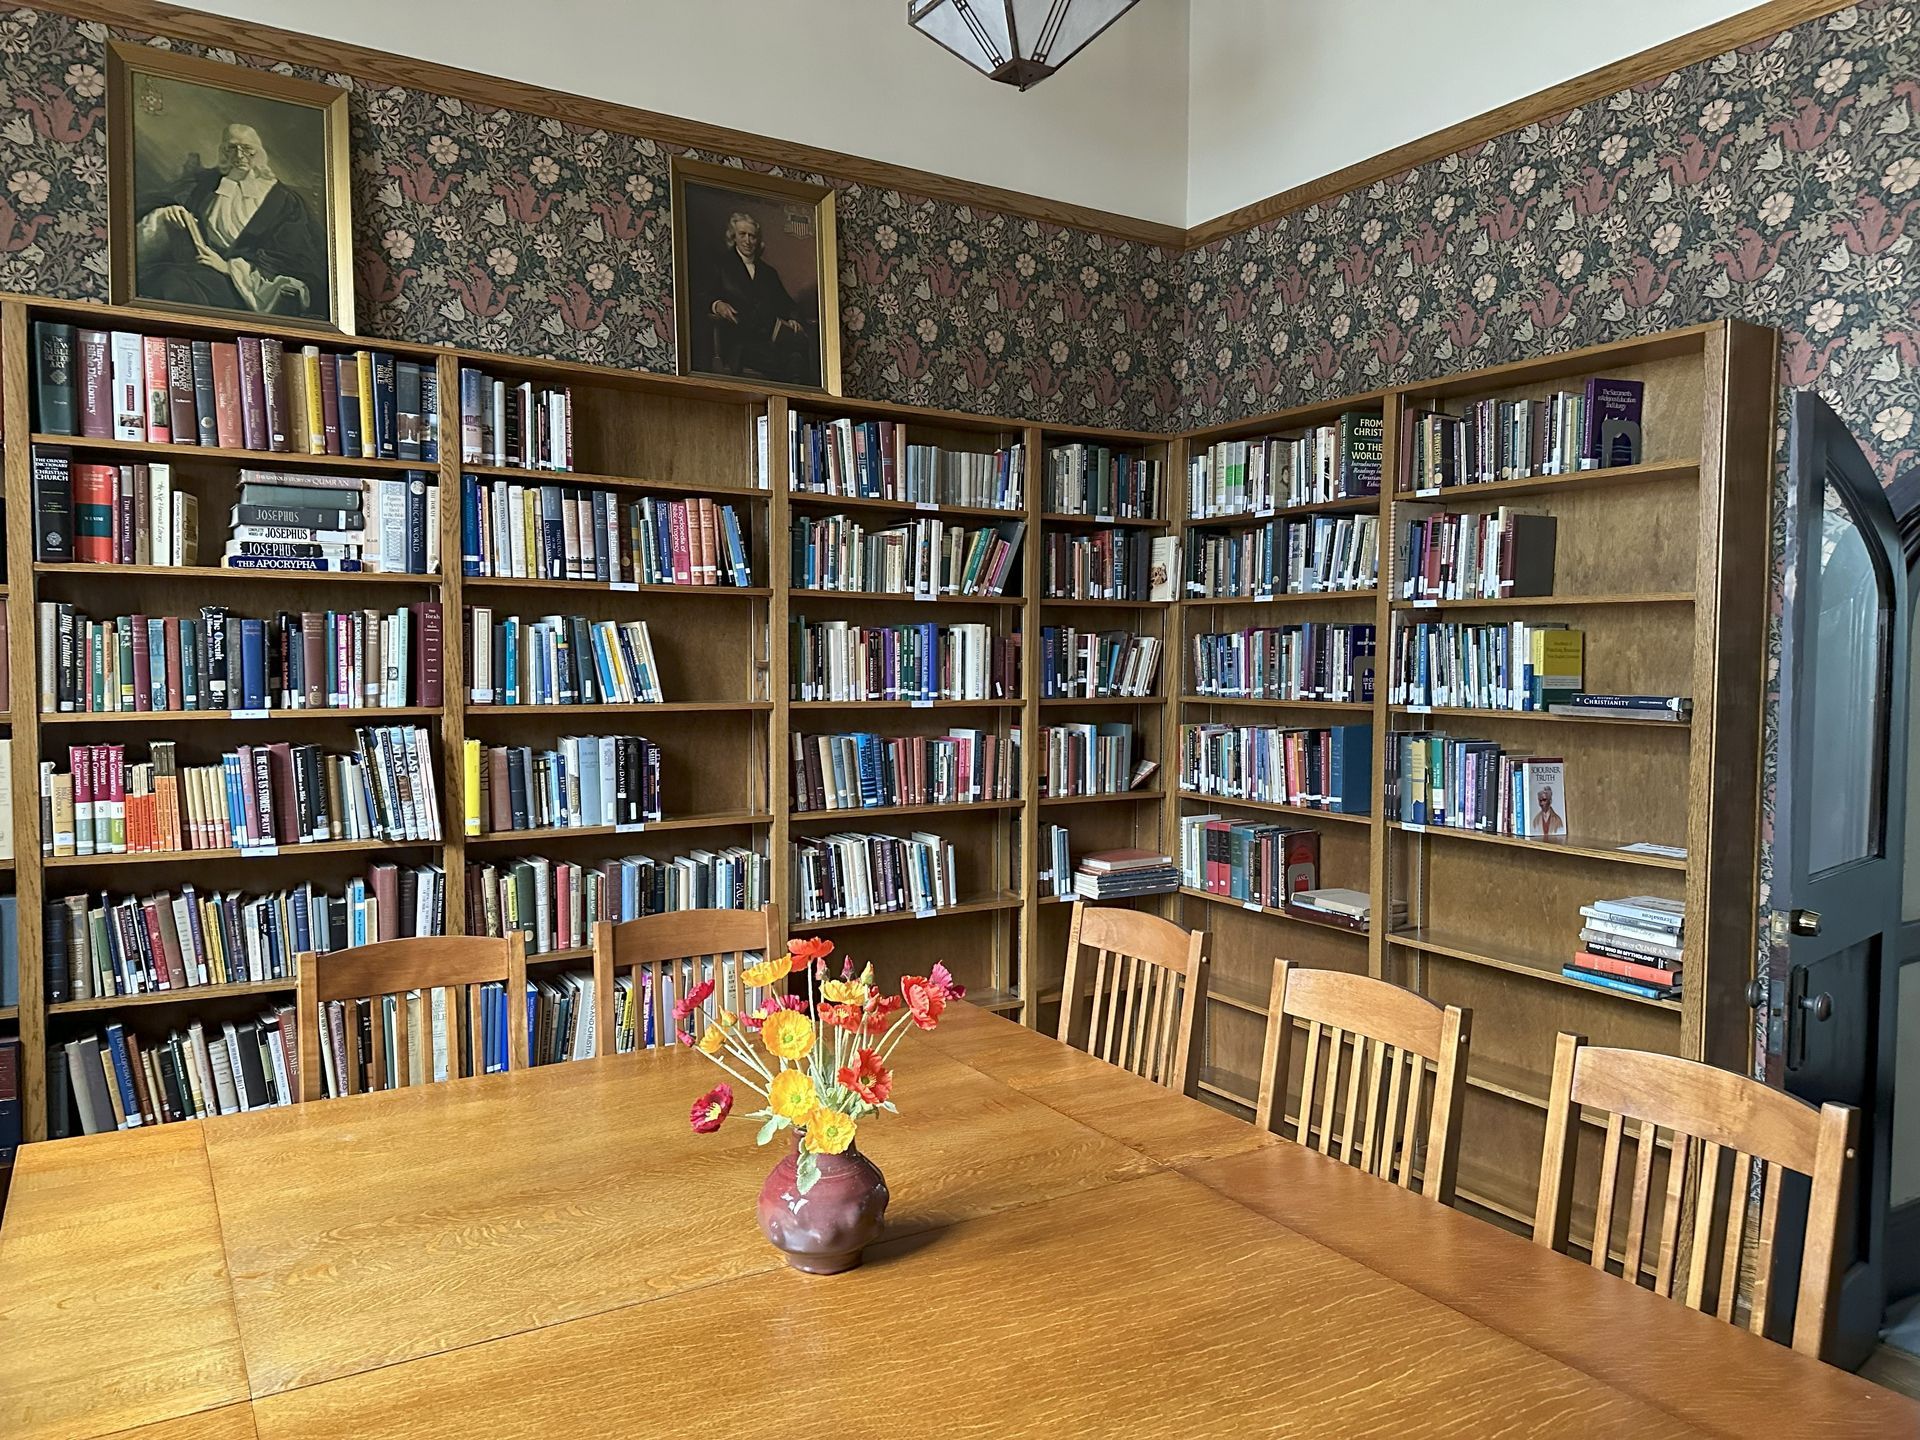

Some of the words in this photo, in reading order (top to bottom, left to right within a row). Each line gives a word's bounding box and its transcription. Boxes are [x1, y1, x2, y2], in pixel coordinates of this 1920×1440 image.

[1614, 403, 1626, 411] Liturgy
[1360, 419, 1383, 427] FROM
[1354, 428, 1383, 436] CHRIST
[1354, 442, 1366, 450] TO
[1368, 443, 1383, 451] THE
[1352, 452, 1382, 460] WORLD
[313, 477, 349, 486] QUMRAN
[256, 510, 300, 522] JOSEPHUS
[609, 510, 617, 522] Old
[265, 528, 308, 539] JOSEPHUS
[677, 506, 685, 545] Encyclopedia
[673, 525, 681, 552] Prophecy
[248, 543, 297, 556] JOSEPHUS
[610, 531, 618, 564] Testament
[237, 560, 255, 568] THE
[256, 559, 317, 569] APOCRYPHA
[60, 614, 72, 635] Billy
[213, 613, 223, 630] The
[61, 635, 73, 667] Graham
[214, 632, 224, 660] Occult
[1584, 698, 1629, 706] CHRISTIANITY
[256, 756, 267, 764] HE
[392, 744, 403, 774] ATLAS
[398, 776, 408, 786] OF
[406, 743, 417, 771] ATLAS
[257, 765, 268, 781] GAVE
[409, 773, 419, 783] OF
[258, 789, 270, 813] STORIES
[318, 778, 326, 815] COMPANION
[411, 786, 421, 803] THE
[261, 814, 270, 833] PRATT
[415, 805, 426, 832] BIBLE
[736, 882, 744, 907] PAUL
[1622, 951, 1654, 962] MYTHOLOGY
[228, 1034, 236, 1047] WHO
[284, 1024, 294, 1048] BIBLE
[585, 1026, 594, 1056] CHRISTIA
[116, 1038, 129, 1080] ENCYCLOPEDIA
[230, 1048, 239, 1065] WROTE
[336, 1038, 344, 1065] THROUGH
[288, 1051, 299, 1076] TIMES
